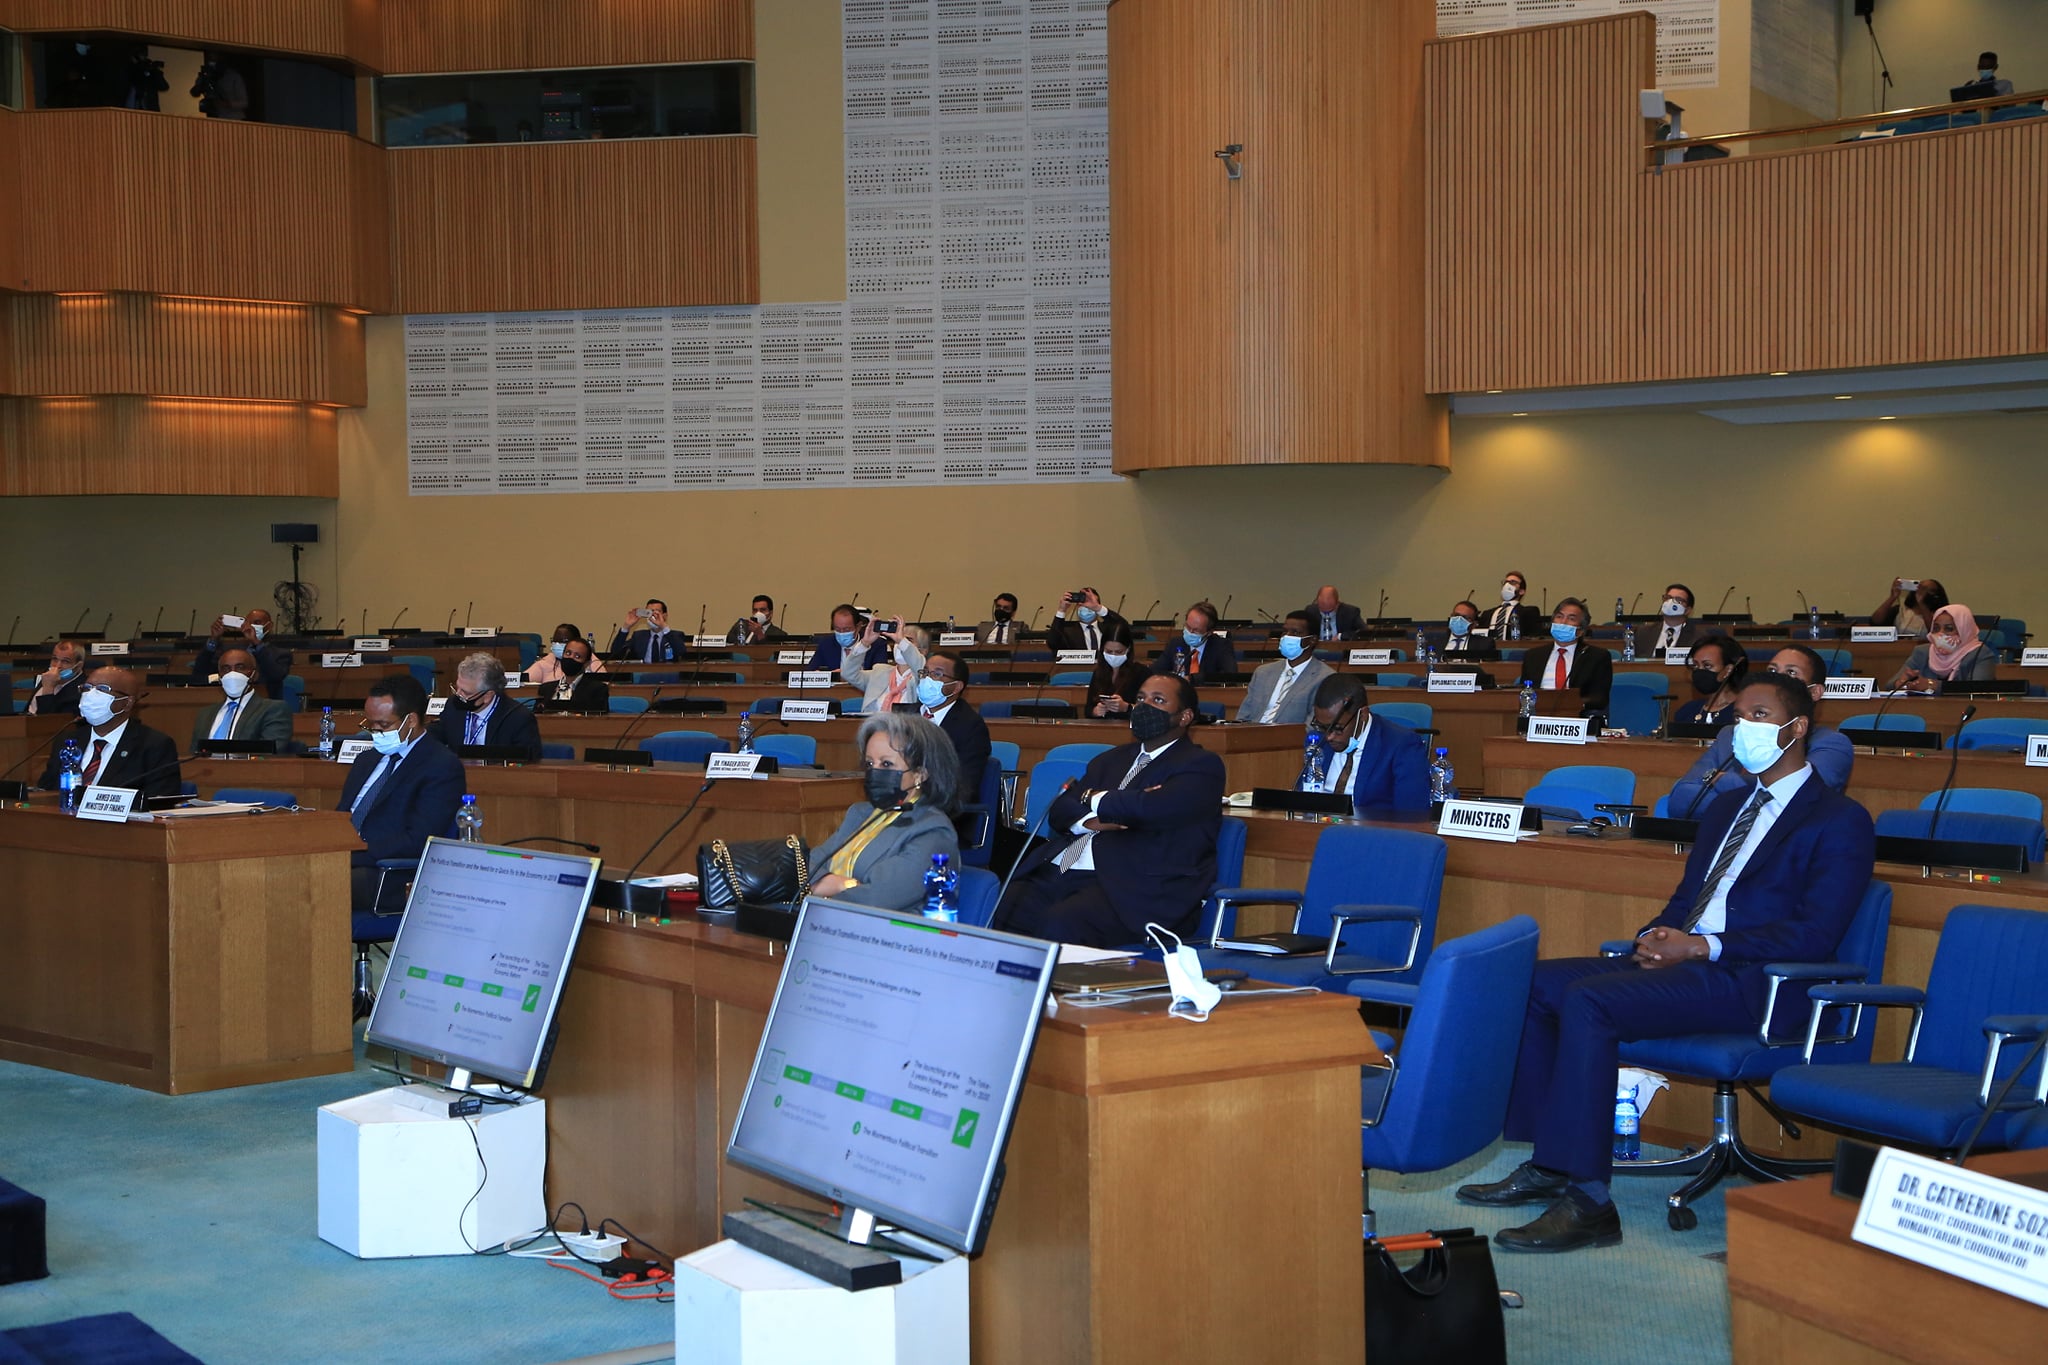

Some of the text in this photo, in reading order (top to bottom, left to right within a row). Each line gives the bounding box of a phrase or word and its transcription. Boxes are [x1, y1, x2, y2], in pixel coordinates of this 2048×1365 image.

[1824, 684, 1866, 693] MINISTERS
[1534, 723, 1580, 736] MINISTERS
[2037, 744, 2048, 757] M
[85, 802, 104, 810] MINISTER
[108, 804, 126, 812] FINANCE
[1450, 809, 1511, 829] MINISTERS
[809, 923, 818, 931] The
[819, 925, 837, 935] Political
[838, 928, 860, 940] Transition
[861, 933, 871, 942] and
[871, 935, 880, 944] the
[908, 943, 924, 953] Quick
[939, 949, 948, 958] the
[949, 951, 975, 964] Economy
[1898, 1173, 2048, 1239] DR. CATHERINE SOZ
[1904, 1203, 1944, 1222] RESIDENT
[1946, 1216, 2010, 1245] COORDINATOR
[2012, 1238, 2032, 1252] AND
[1898, 1217, 2028, 1270] HUMANITARIAN COORDINATOR
